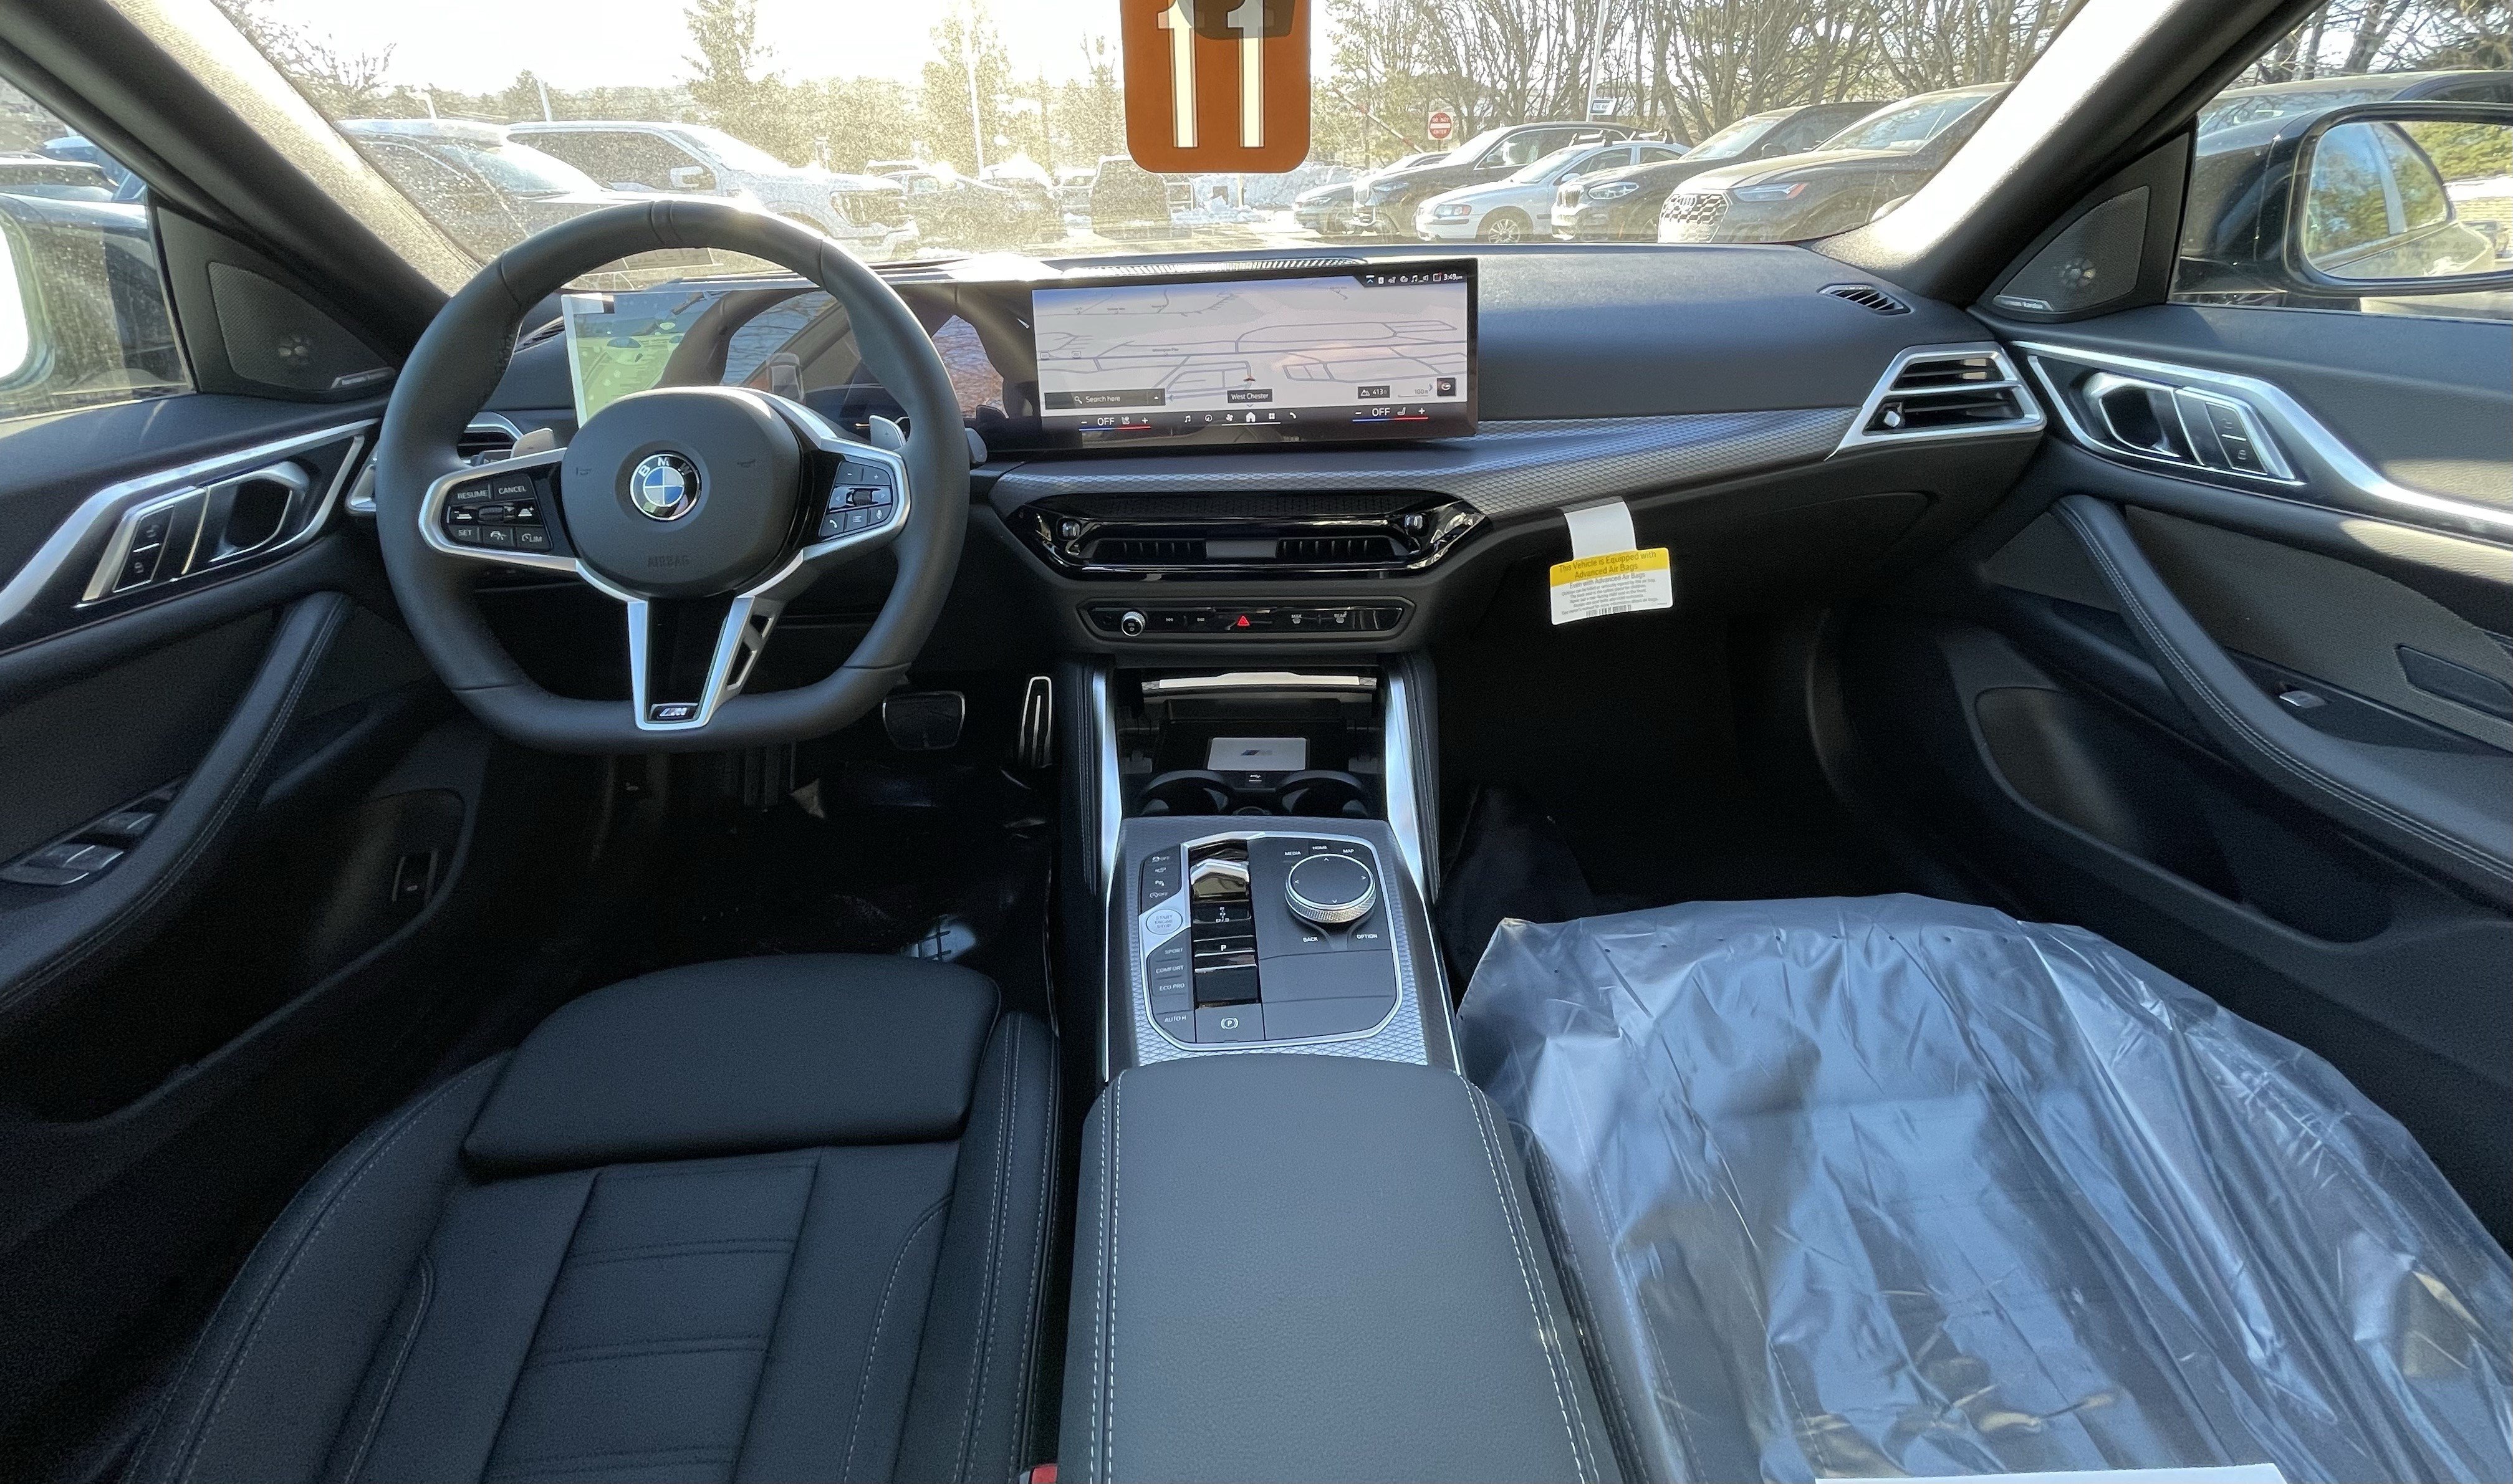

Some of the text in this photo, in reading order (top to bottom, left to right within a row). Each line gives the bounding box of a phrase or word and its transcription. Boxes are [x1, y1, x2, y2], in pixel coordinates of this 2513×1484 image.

[1158, 0, 1264, 148] 11
[1372, 407, 1391, 416] OFF
[1097, 417, 1115, 426] OFF
[638, 456, 693, 477] BMW
[457, 489, 489, 499] RESUME
[498, 485, 527, 495] CANCEL
[1559, 565, 1572, 573] This
[1573, 560, 1597, 570] Vehicle
[1606, 553, 1639, 565] Equipped
[1575, 567, 1607, 579] Advanced
[1620, 563, 1638, 572] Bags
[1595, 576, 1622, 585] Advanced
[1155, 964, 1184, 974] COMFORT
